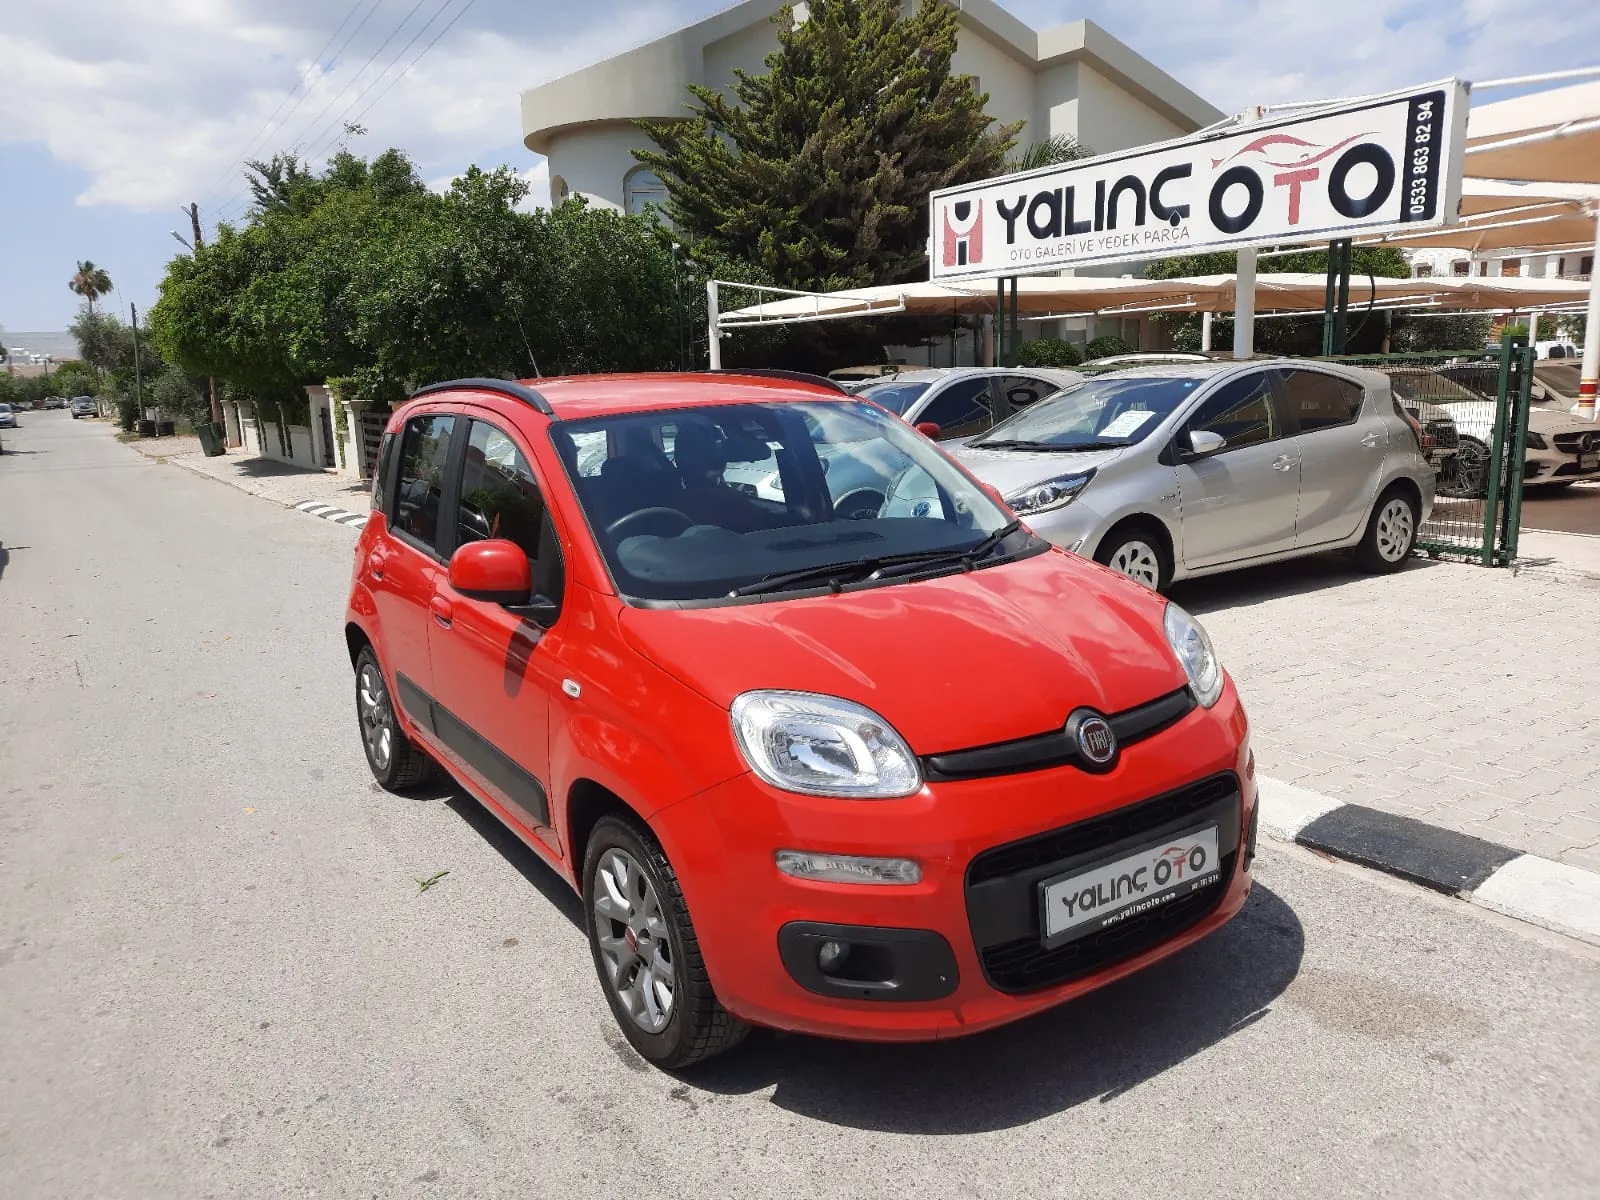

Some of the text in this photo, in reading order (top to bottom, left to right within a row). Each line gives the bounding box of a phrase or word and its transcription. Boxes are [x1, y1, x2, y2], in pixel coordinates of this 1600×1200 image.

[1409, 100, 1434, 214] 0533 863 82 94
[1208, 142, 1396, 234] OTO
[1010, 225, 1190, 262] OTO GALERİ VE YEDEK PARÇA
[1088, 729, 1111, 752] FIAT
[1153, 846, 1206, 886] OTO
